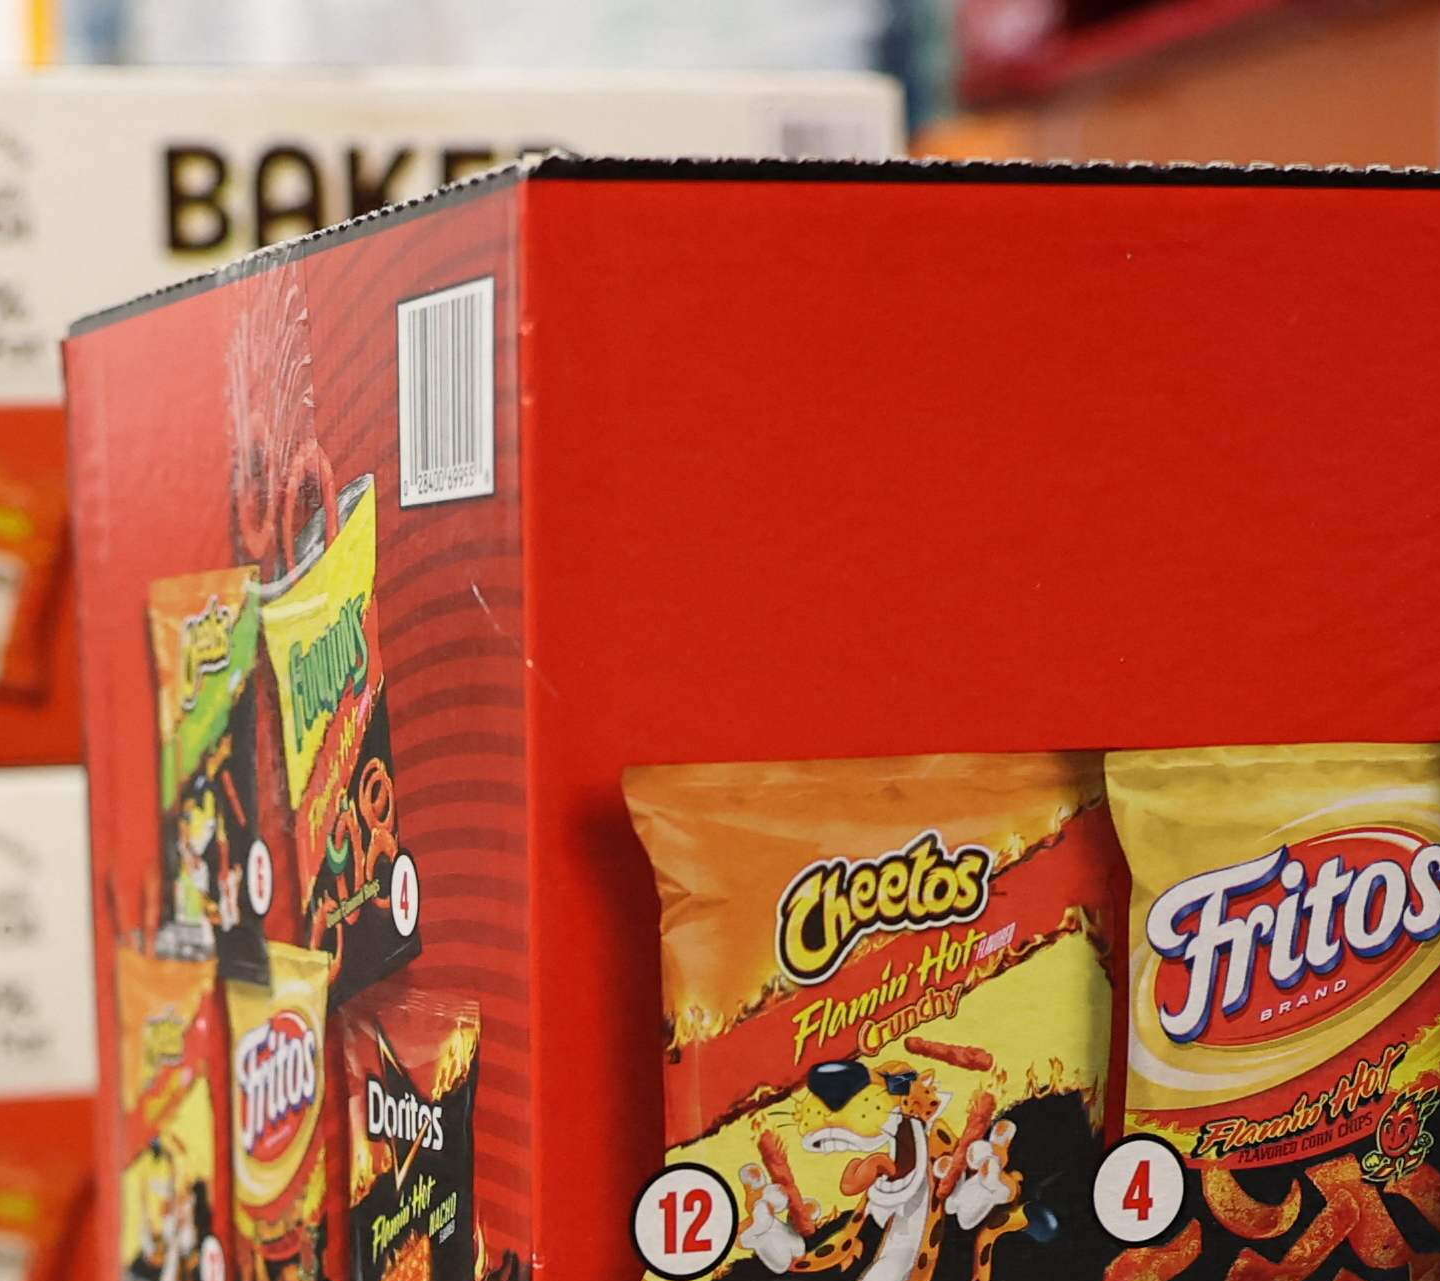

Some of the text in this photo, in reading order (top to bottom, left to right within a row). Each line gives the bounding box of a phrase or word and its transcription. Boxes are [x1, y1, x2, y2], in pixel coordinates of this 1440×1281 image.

[399, 870, 409, 921] 4
[776, 830, 990, 985] Cheetos
[791, 921, 1016, 1066] Flamin' Hot FLAVORED
[857, 982, 963, 1056] Crunchy
[1260, 978, 1348, 1023] BRAND
[237, 1018, 316, 1147] Fritos
[368, 1079, 443, 1151] Doritos
[1198, 1042, 1406, 1157] Flamin' Hot
[1237, 1112, 1373, 1166] FLAVORED CORN CHIPS
[658, 1188, 712, 1256] 12
[1121, 1158, 1153, 1221] 4
